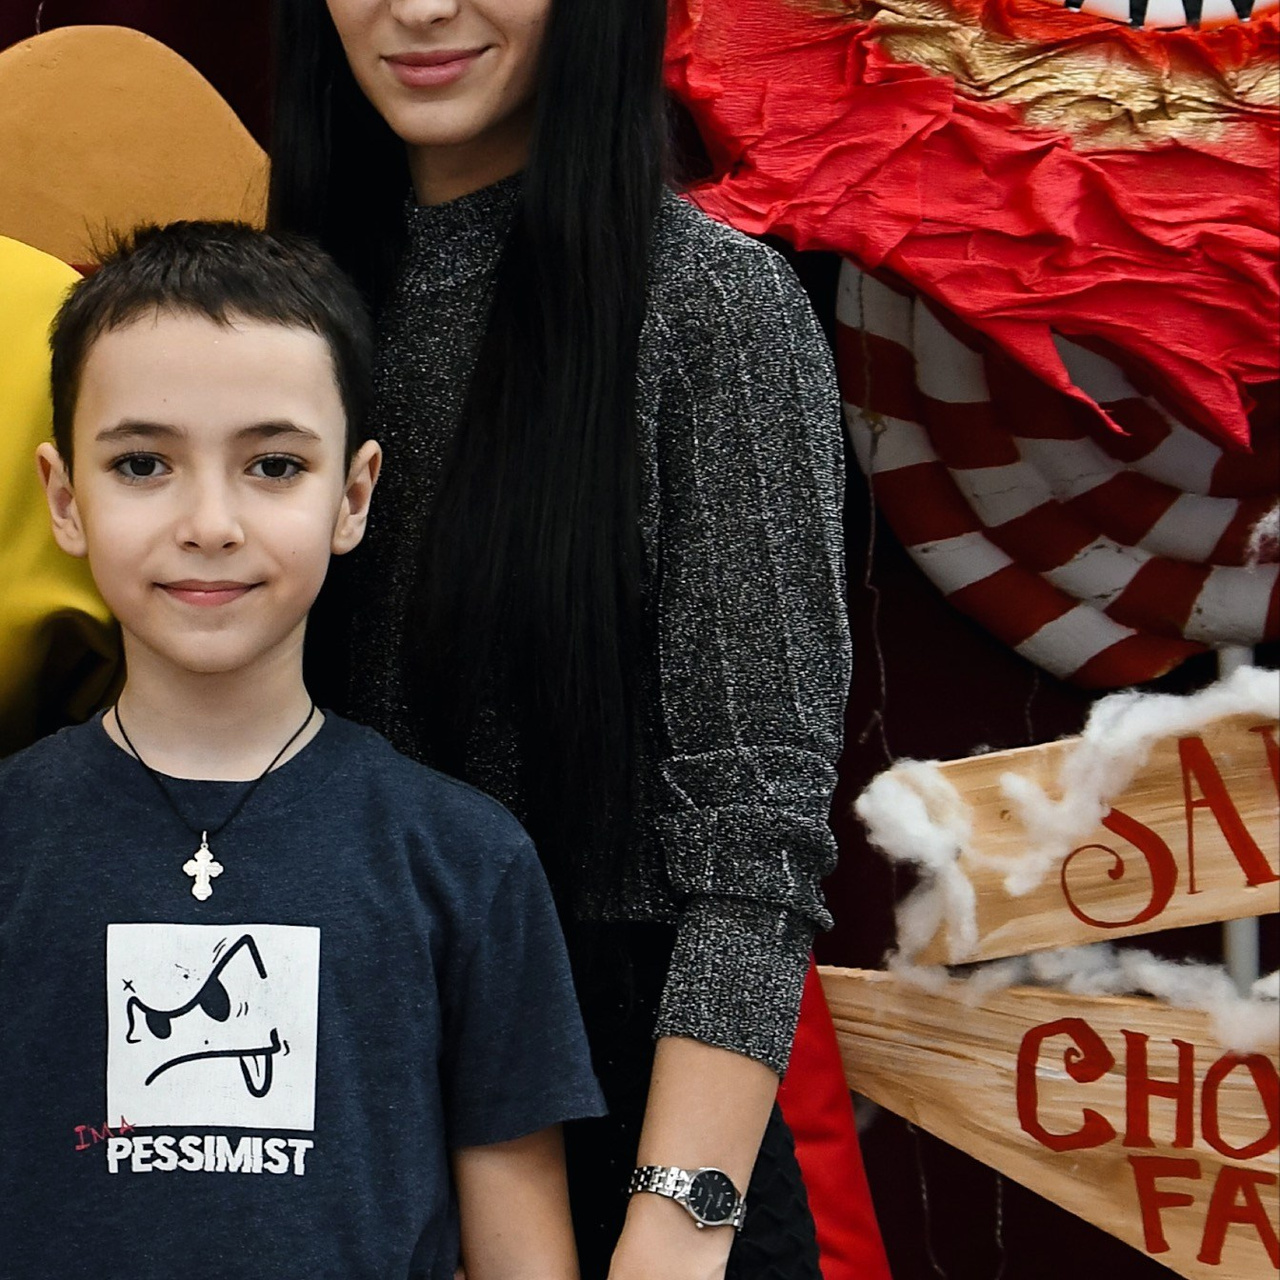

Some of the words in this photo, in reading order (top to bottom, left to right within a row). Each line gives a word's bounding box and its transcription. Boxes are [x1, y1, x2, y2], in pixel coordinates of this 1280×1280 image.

[1061, 724, 1280, 929] SA
[119, 1114, 137, 1136] A
[1016, 1016, 1280, 1161] CHO
[107, 1135, 315, 1176] PESSIMIST
[1130, 1154, 1280, 1270] FA
